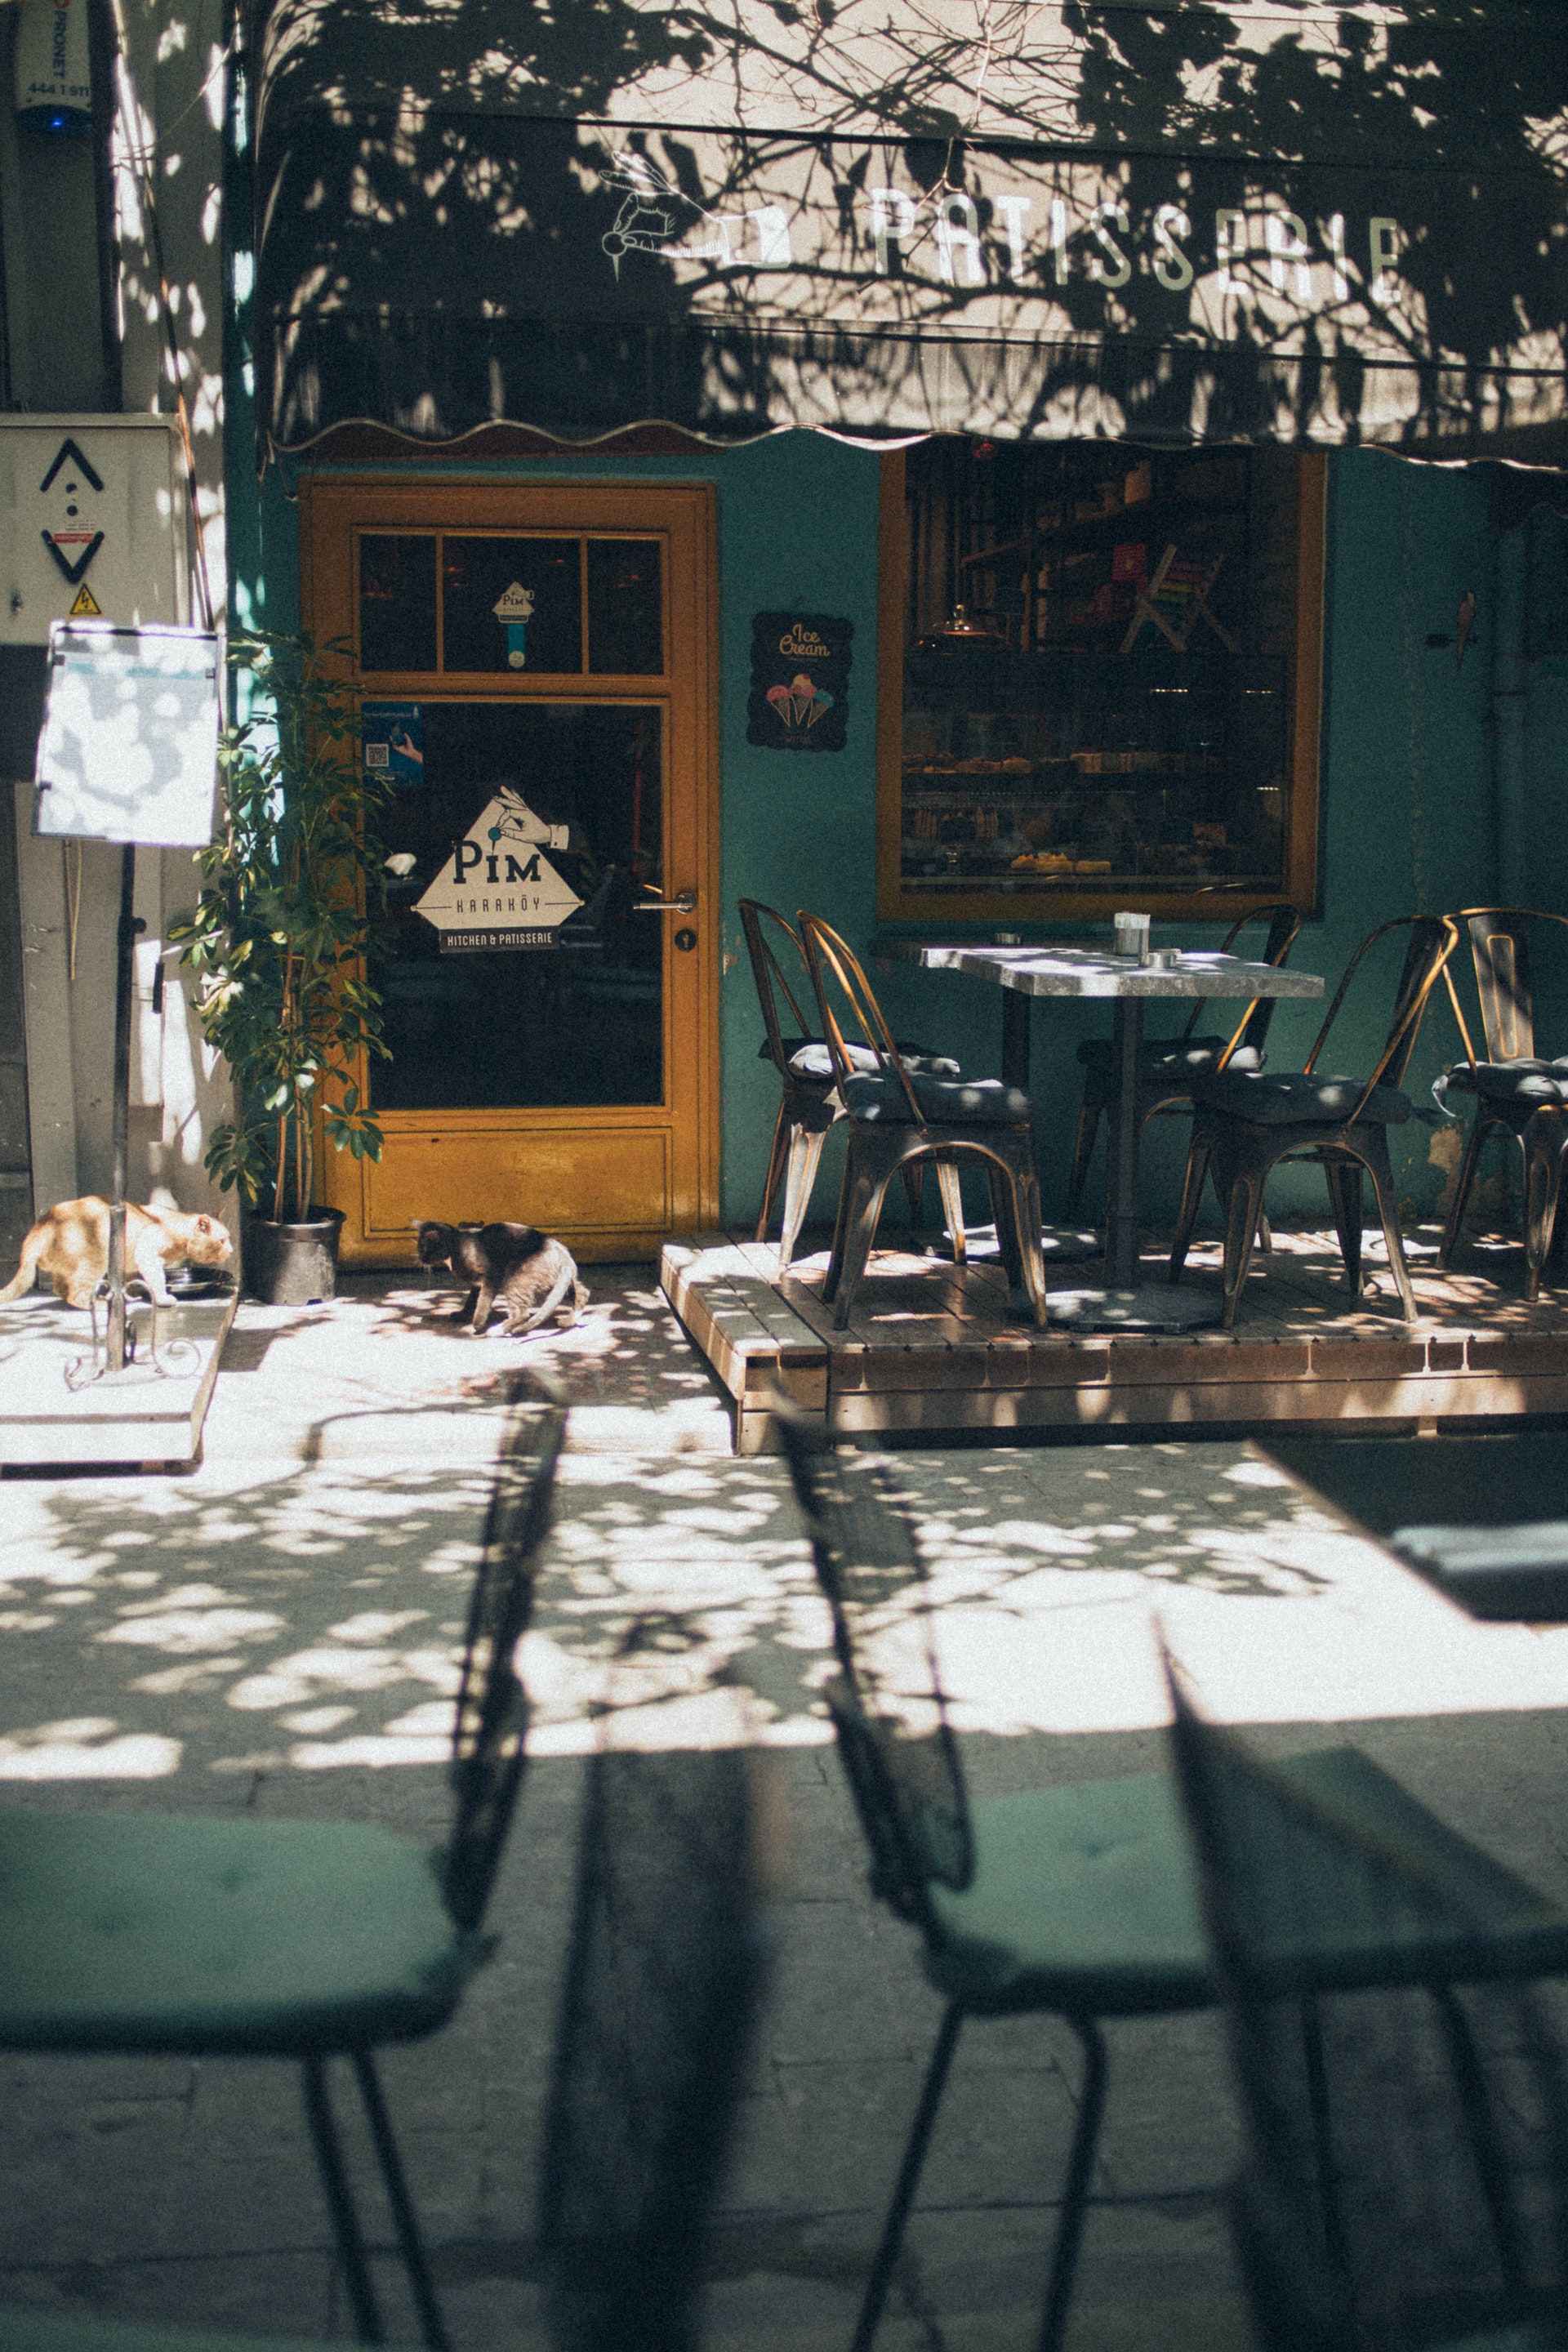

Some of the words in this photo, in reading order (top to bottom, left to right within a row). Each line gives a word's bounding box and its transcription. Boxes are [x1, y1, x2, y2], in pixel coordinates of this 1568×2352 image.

[53, 10, 66, 79] PRONET
[28, 82, 56, 94] 444
[871, 188, 1401, 303] PATISSERIE
[503, 595, 523, 605] PIM
[792, 623, 821, 642] Ice
[779, 635, 831, 657] Cream
[452, 840, 541, 884] PIM
[457, 894, 540, 913] KARAKÖY
[447, 934, 487, 947] KITCHEN
[490, 934, 497, 946] &
[499, 933, 553, 945] PATISSERIE
